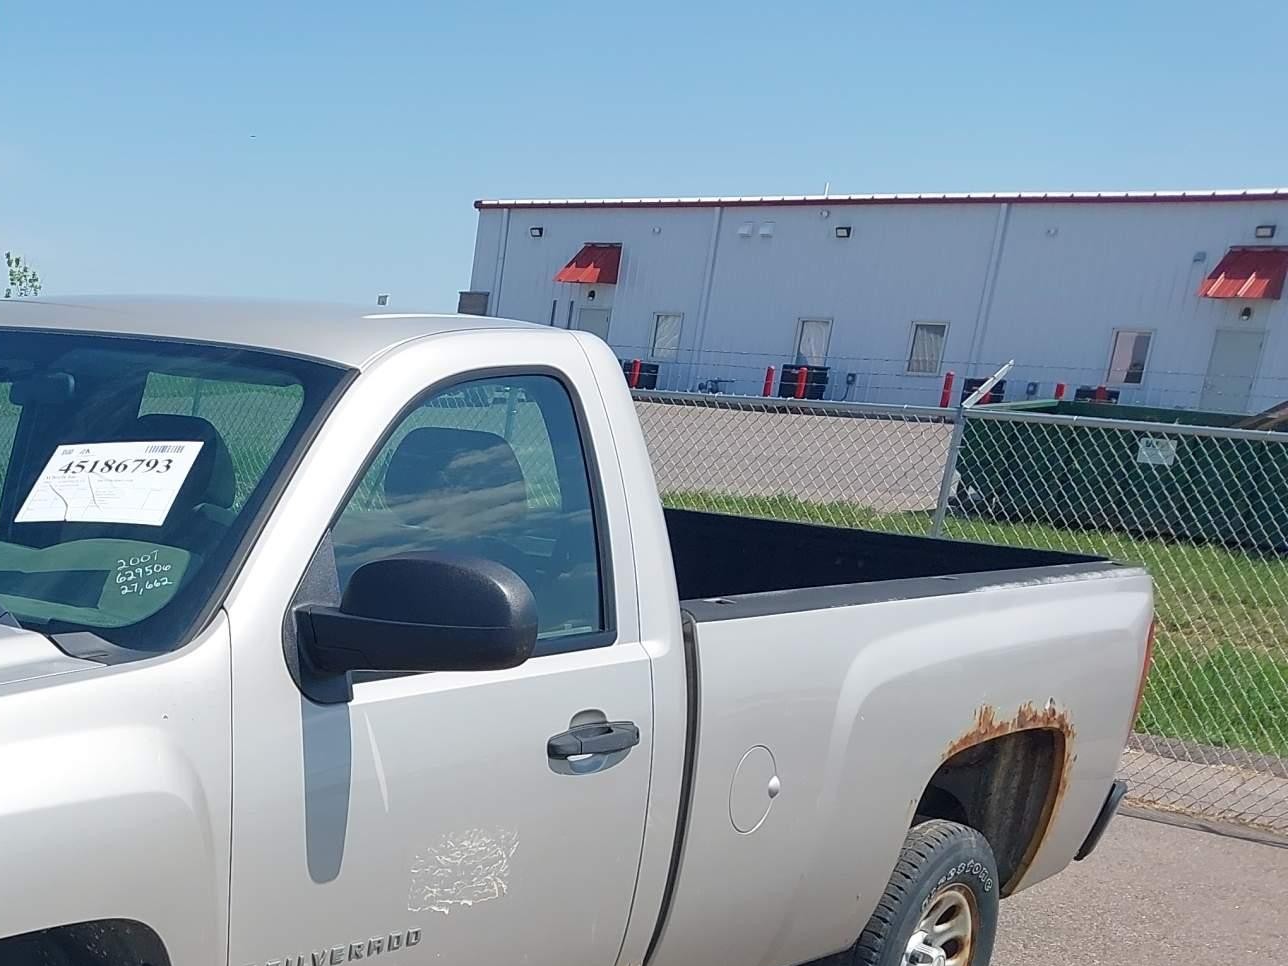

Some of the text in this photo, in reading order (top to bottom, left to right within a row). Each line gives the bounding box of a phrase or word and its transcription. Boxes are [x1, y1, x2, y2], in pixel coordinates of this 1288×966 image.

[58, 458, 174, 474] 45186793
[117, 549, 159, 571] 2007
[116, 564, 171, 583] 629506
[120, 577, 175, 595] 27,662
